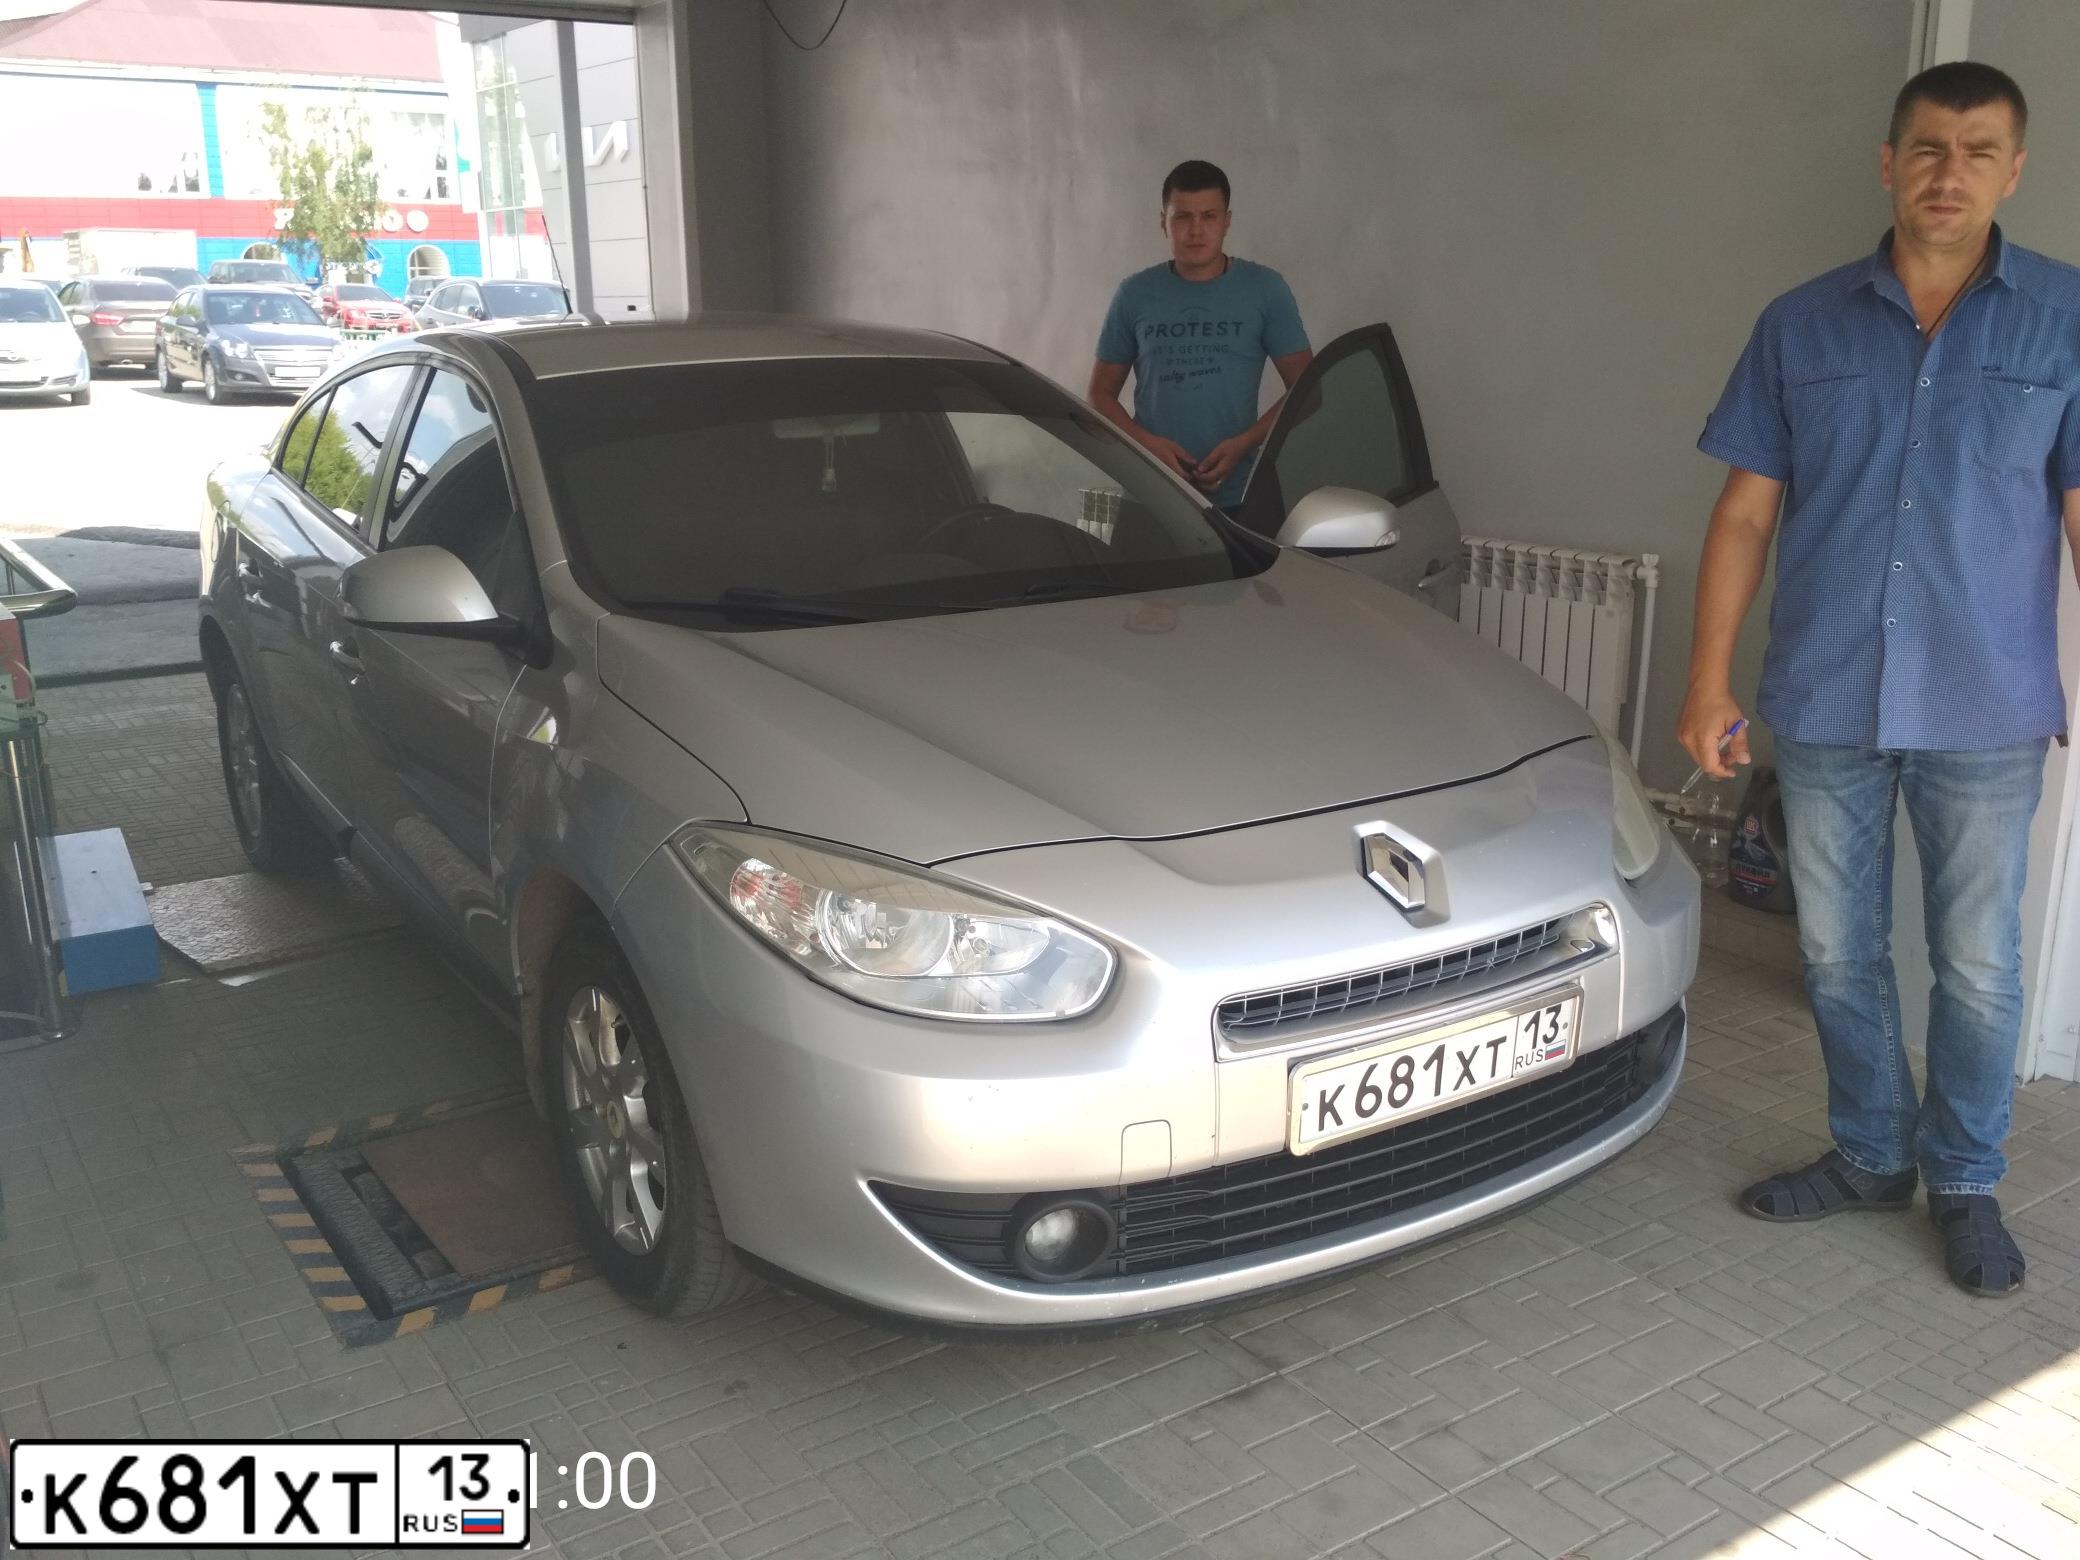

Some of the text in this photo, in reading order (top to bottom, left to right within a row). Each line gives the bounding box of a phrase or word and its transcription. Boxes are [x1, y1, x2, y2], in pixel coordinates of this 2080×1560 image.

[1144, 321, 1244, 340] PROTEST
[1178, 343, 1230, 354] GETTING
[1523, 1004, 1563, 1050] 13
[1515, 1048, 1544, 1070] RUS
